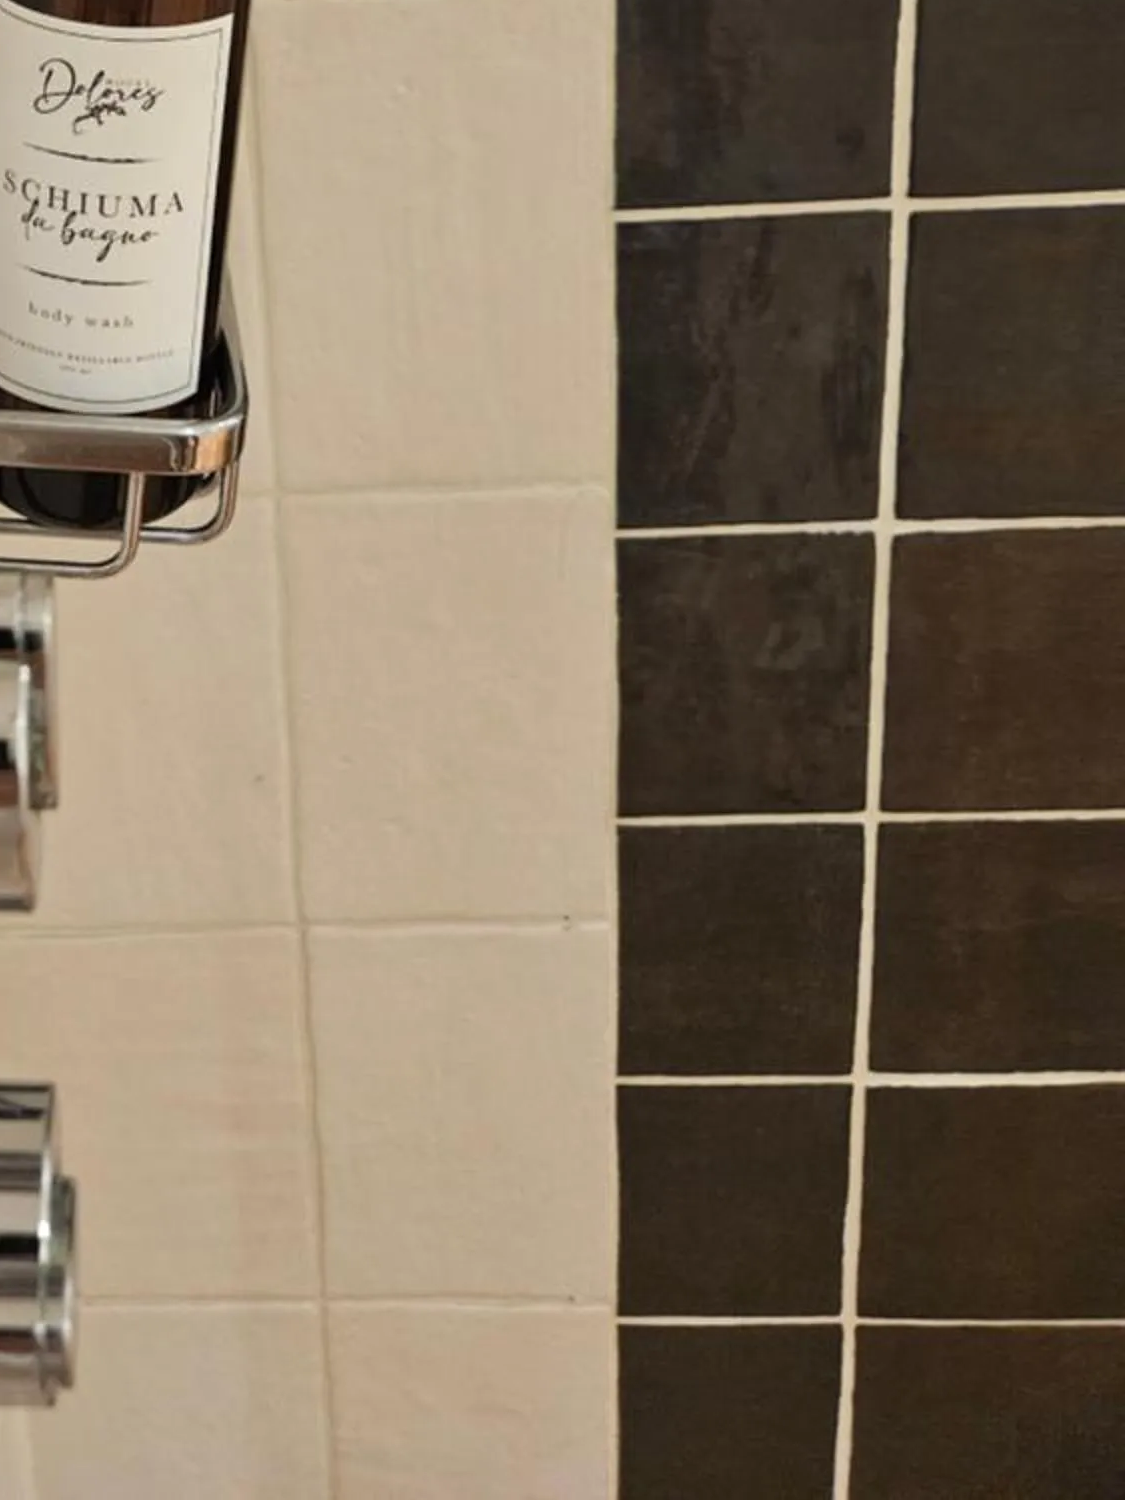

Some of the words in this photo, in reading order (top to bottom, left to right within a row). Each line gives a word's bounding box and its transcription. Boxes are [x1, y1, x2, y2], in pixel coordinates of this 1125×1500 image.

[2, 169, 184, 219] SCHIUMA
[28, 300, 74, 325] body
[85, 315, 135, 328] wash
